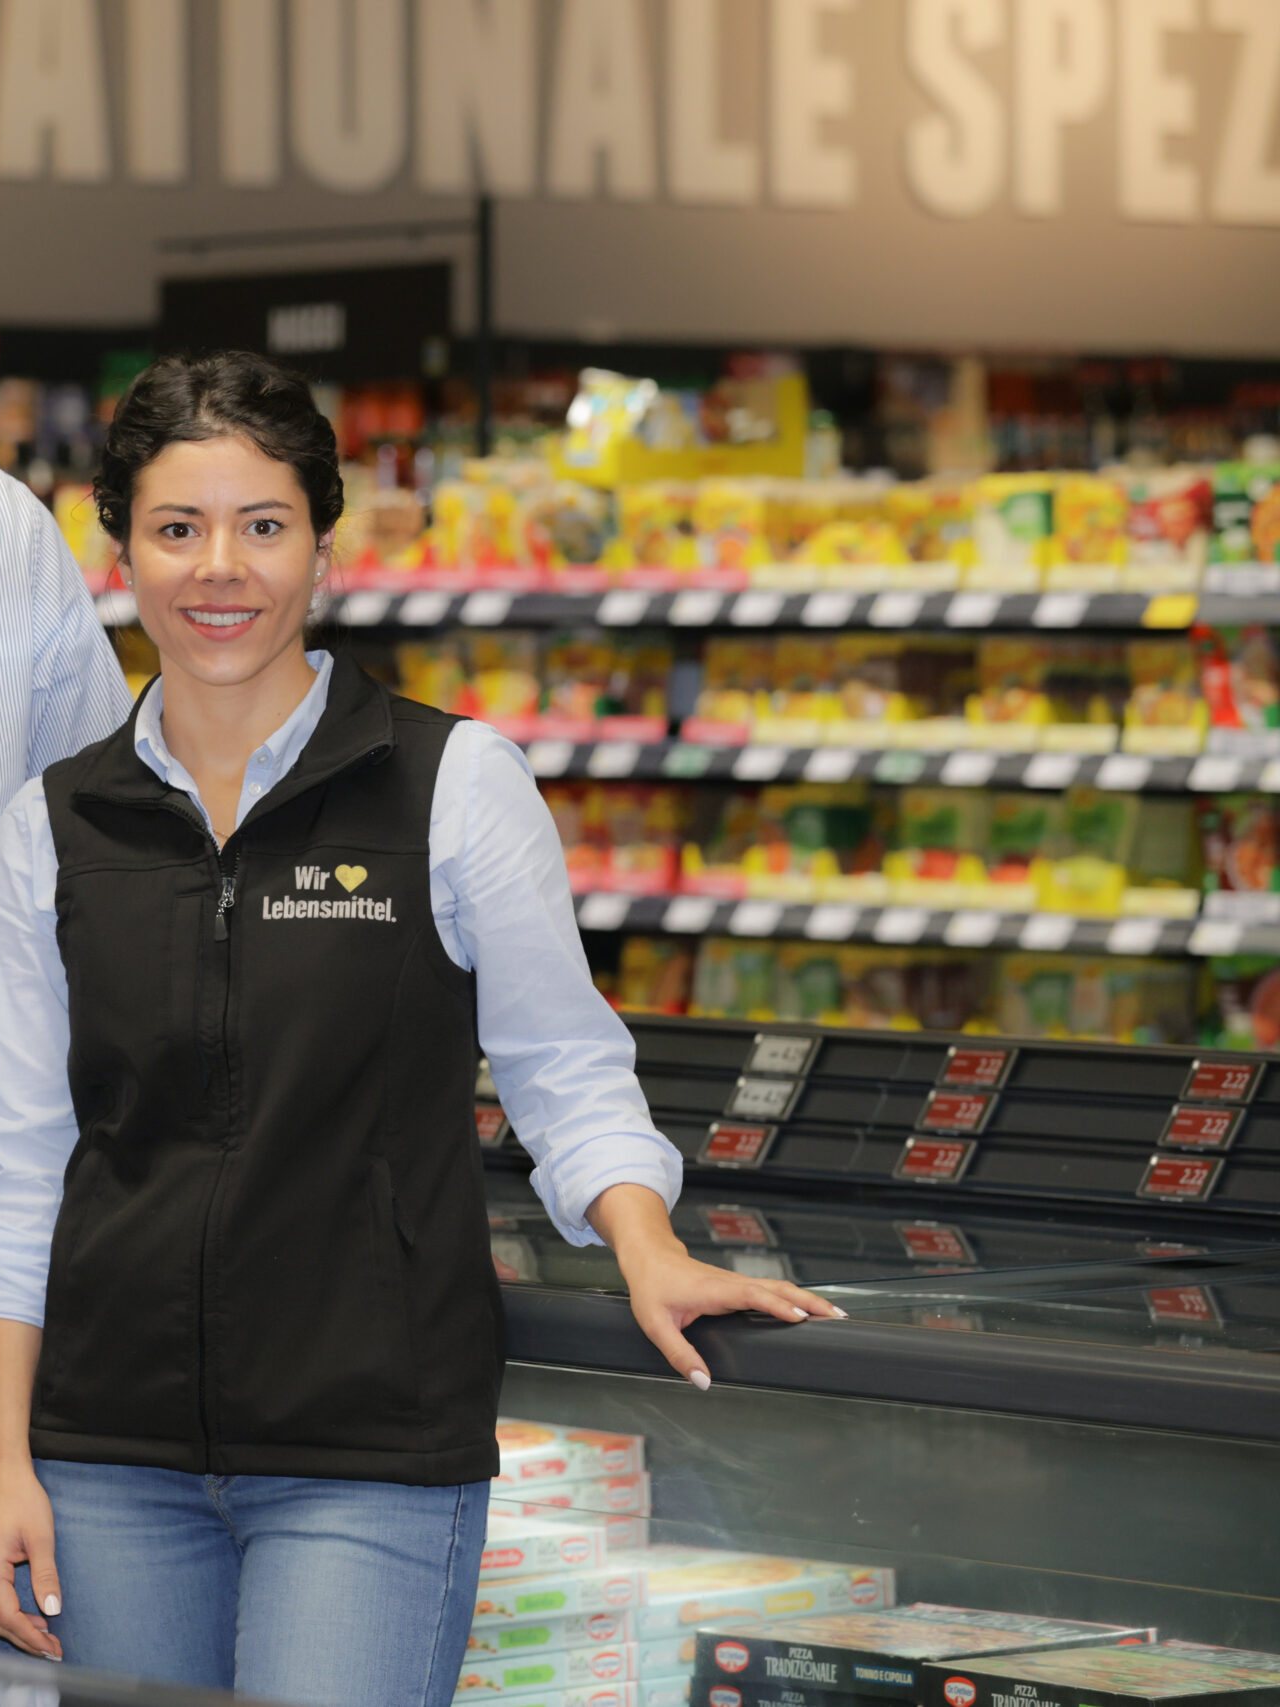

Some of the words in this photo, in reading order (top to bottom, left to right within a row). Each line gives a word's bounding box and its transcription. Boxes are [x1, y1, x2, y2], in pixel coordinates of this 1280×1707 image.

[295, 866, 330, 891] Wir
[262, 895, 397, 923] Lebensmittel.
[1222, 1072, 1250, 1089] 2.22
[1201, 1118, 1230, 1134] 2.22
[1179, 1168, 1208, 1185] 2.22
[788, 1647, 813, 1660] PIZZA
[765, 1656, 838, 1683] TRADIZIONALE
[885, 1670, 913, 1684] CIPOLLA
[1014, 1684, 1038, 1698] PIZZA
[991, 1693, 1061, 1707] TRADIZI
